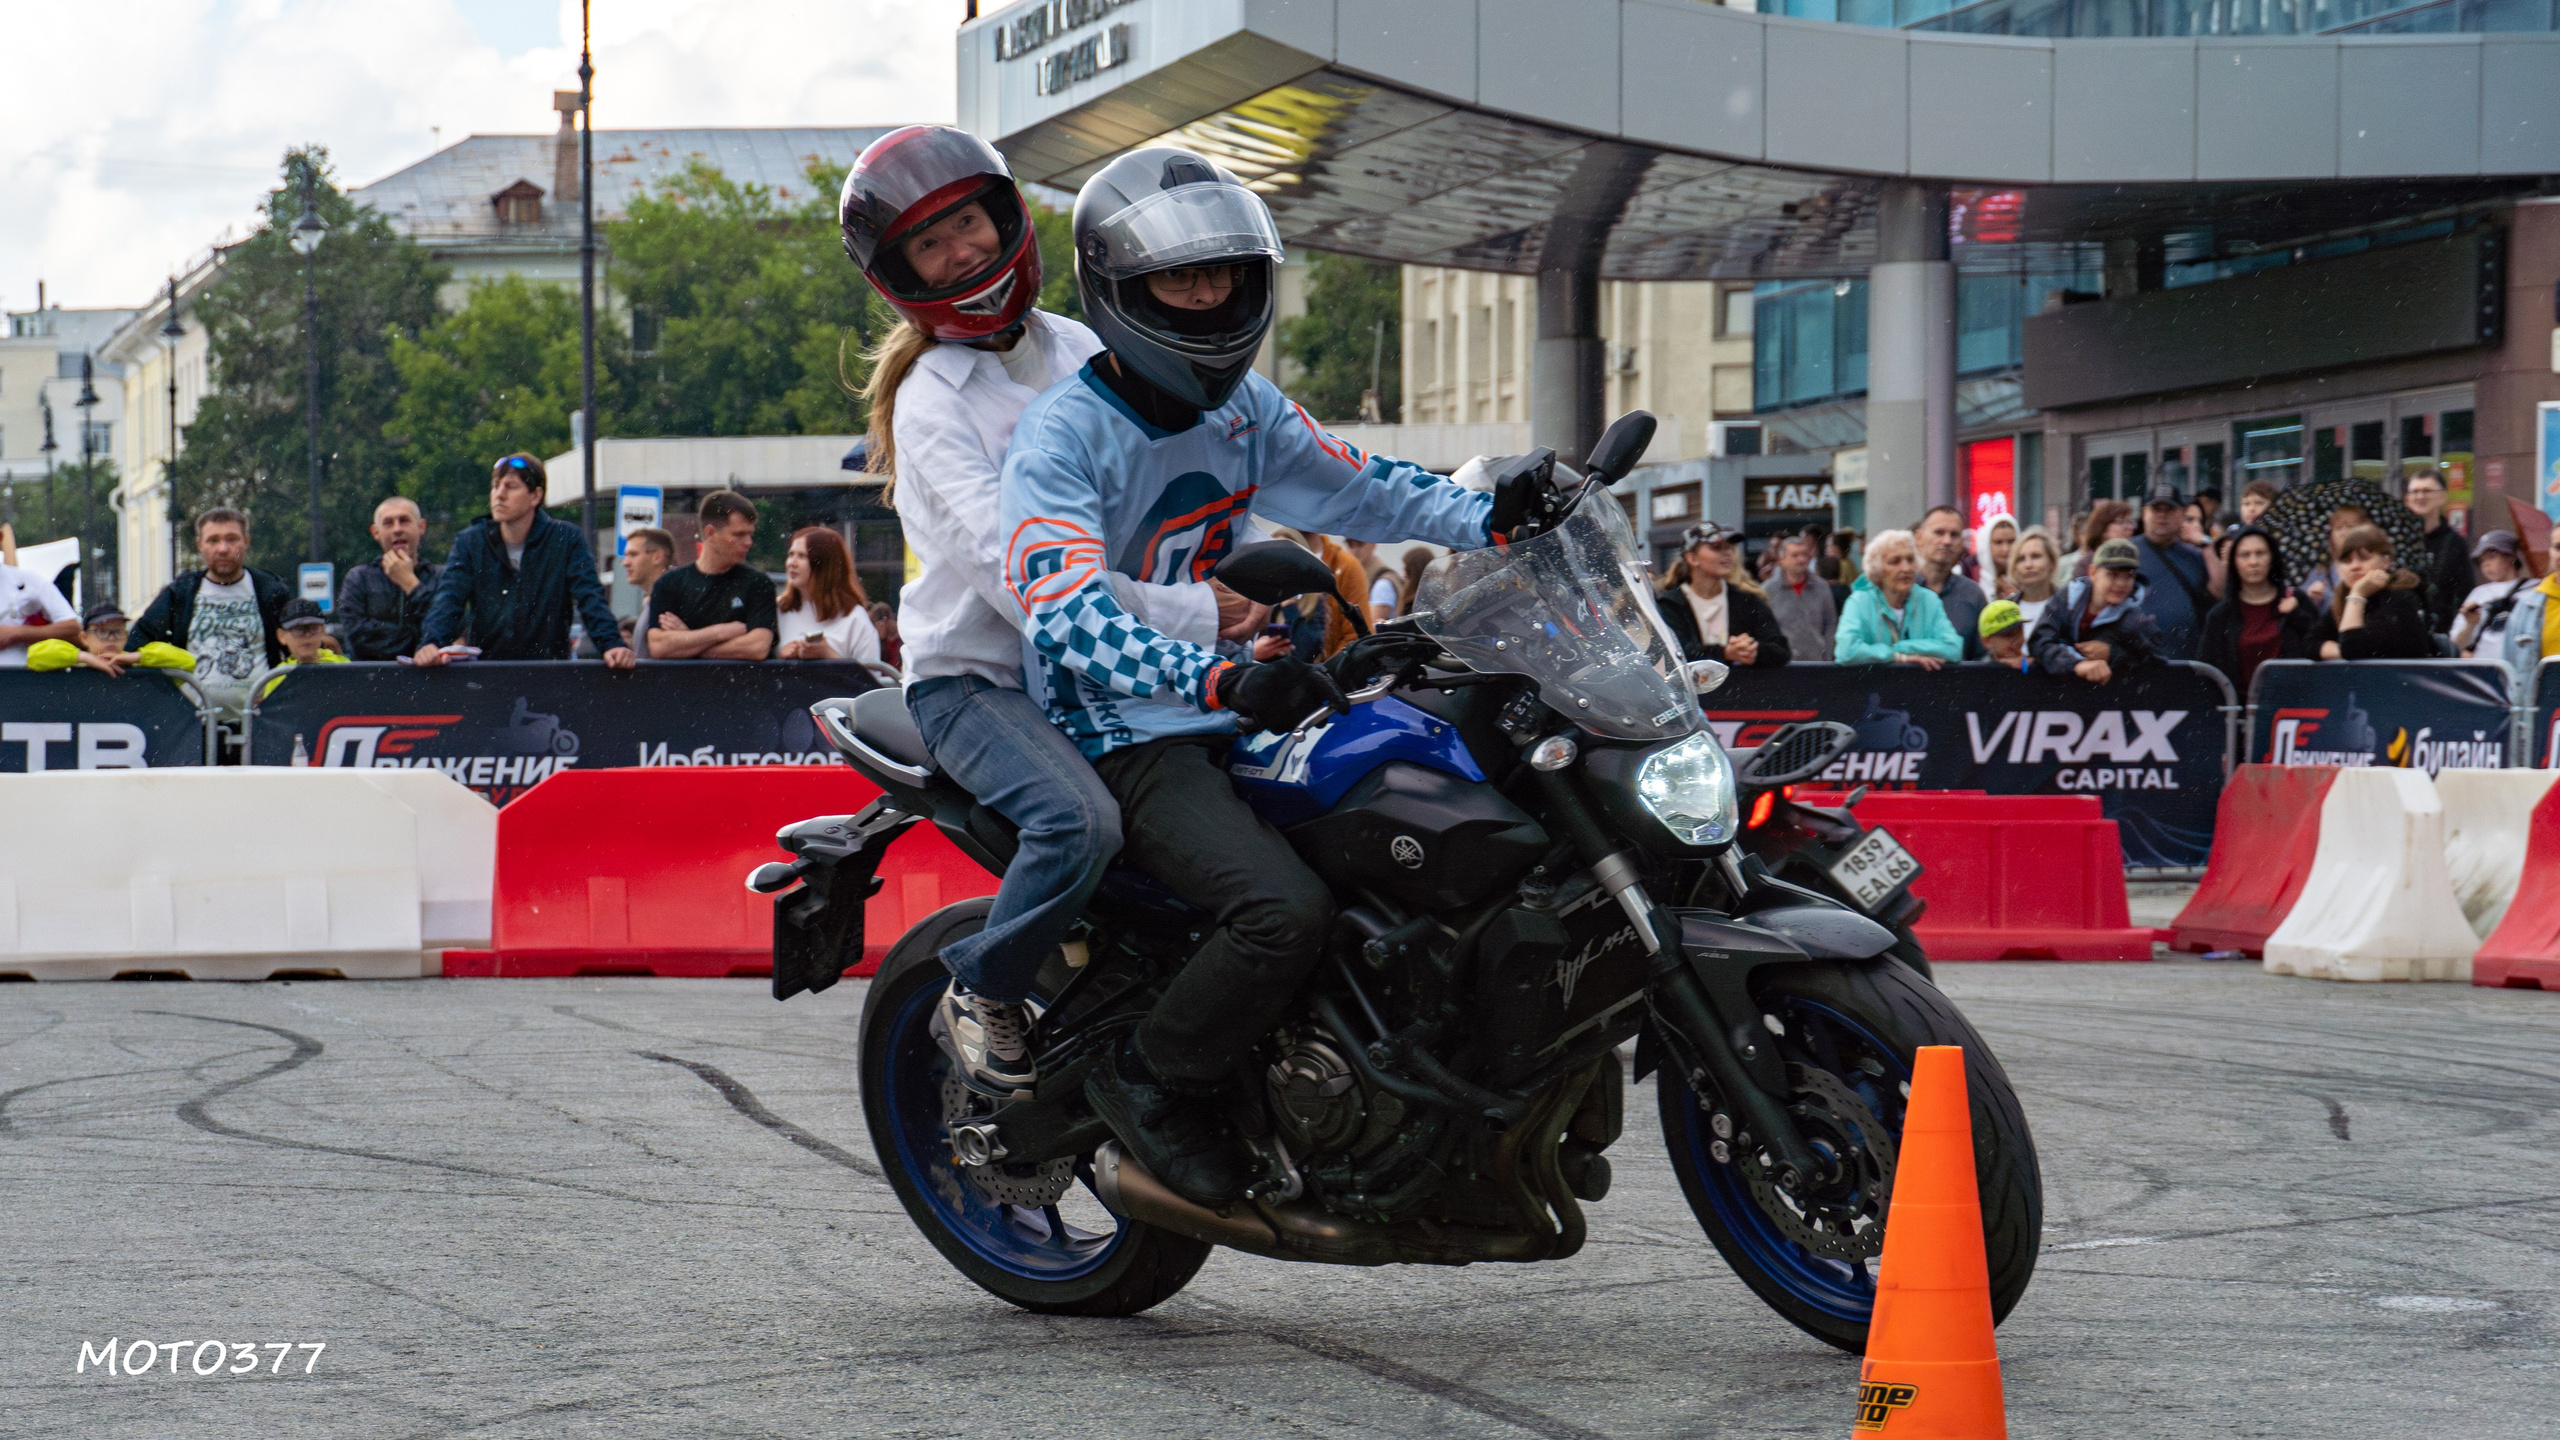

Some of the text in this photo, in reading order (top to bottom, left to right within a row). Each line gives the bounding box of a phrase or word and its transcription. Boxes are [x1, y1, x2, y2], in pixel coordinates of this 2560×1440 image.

[1965, 710, 2189, 764] VIRAX
[2056, 768, 2180, 789] CAPITAL
[1843, 839, 1884, 876] 1839
[1886, 856, 1911, 879] 66
